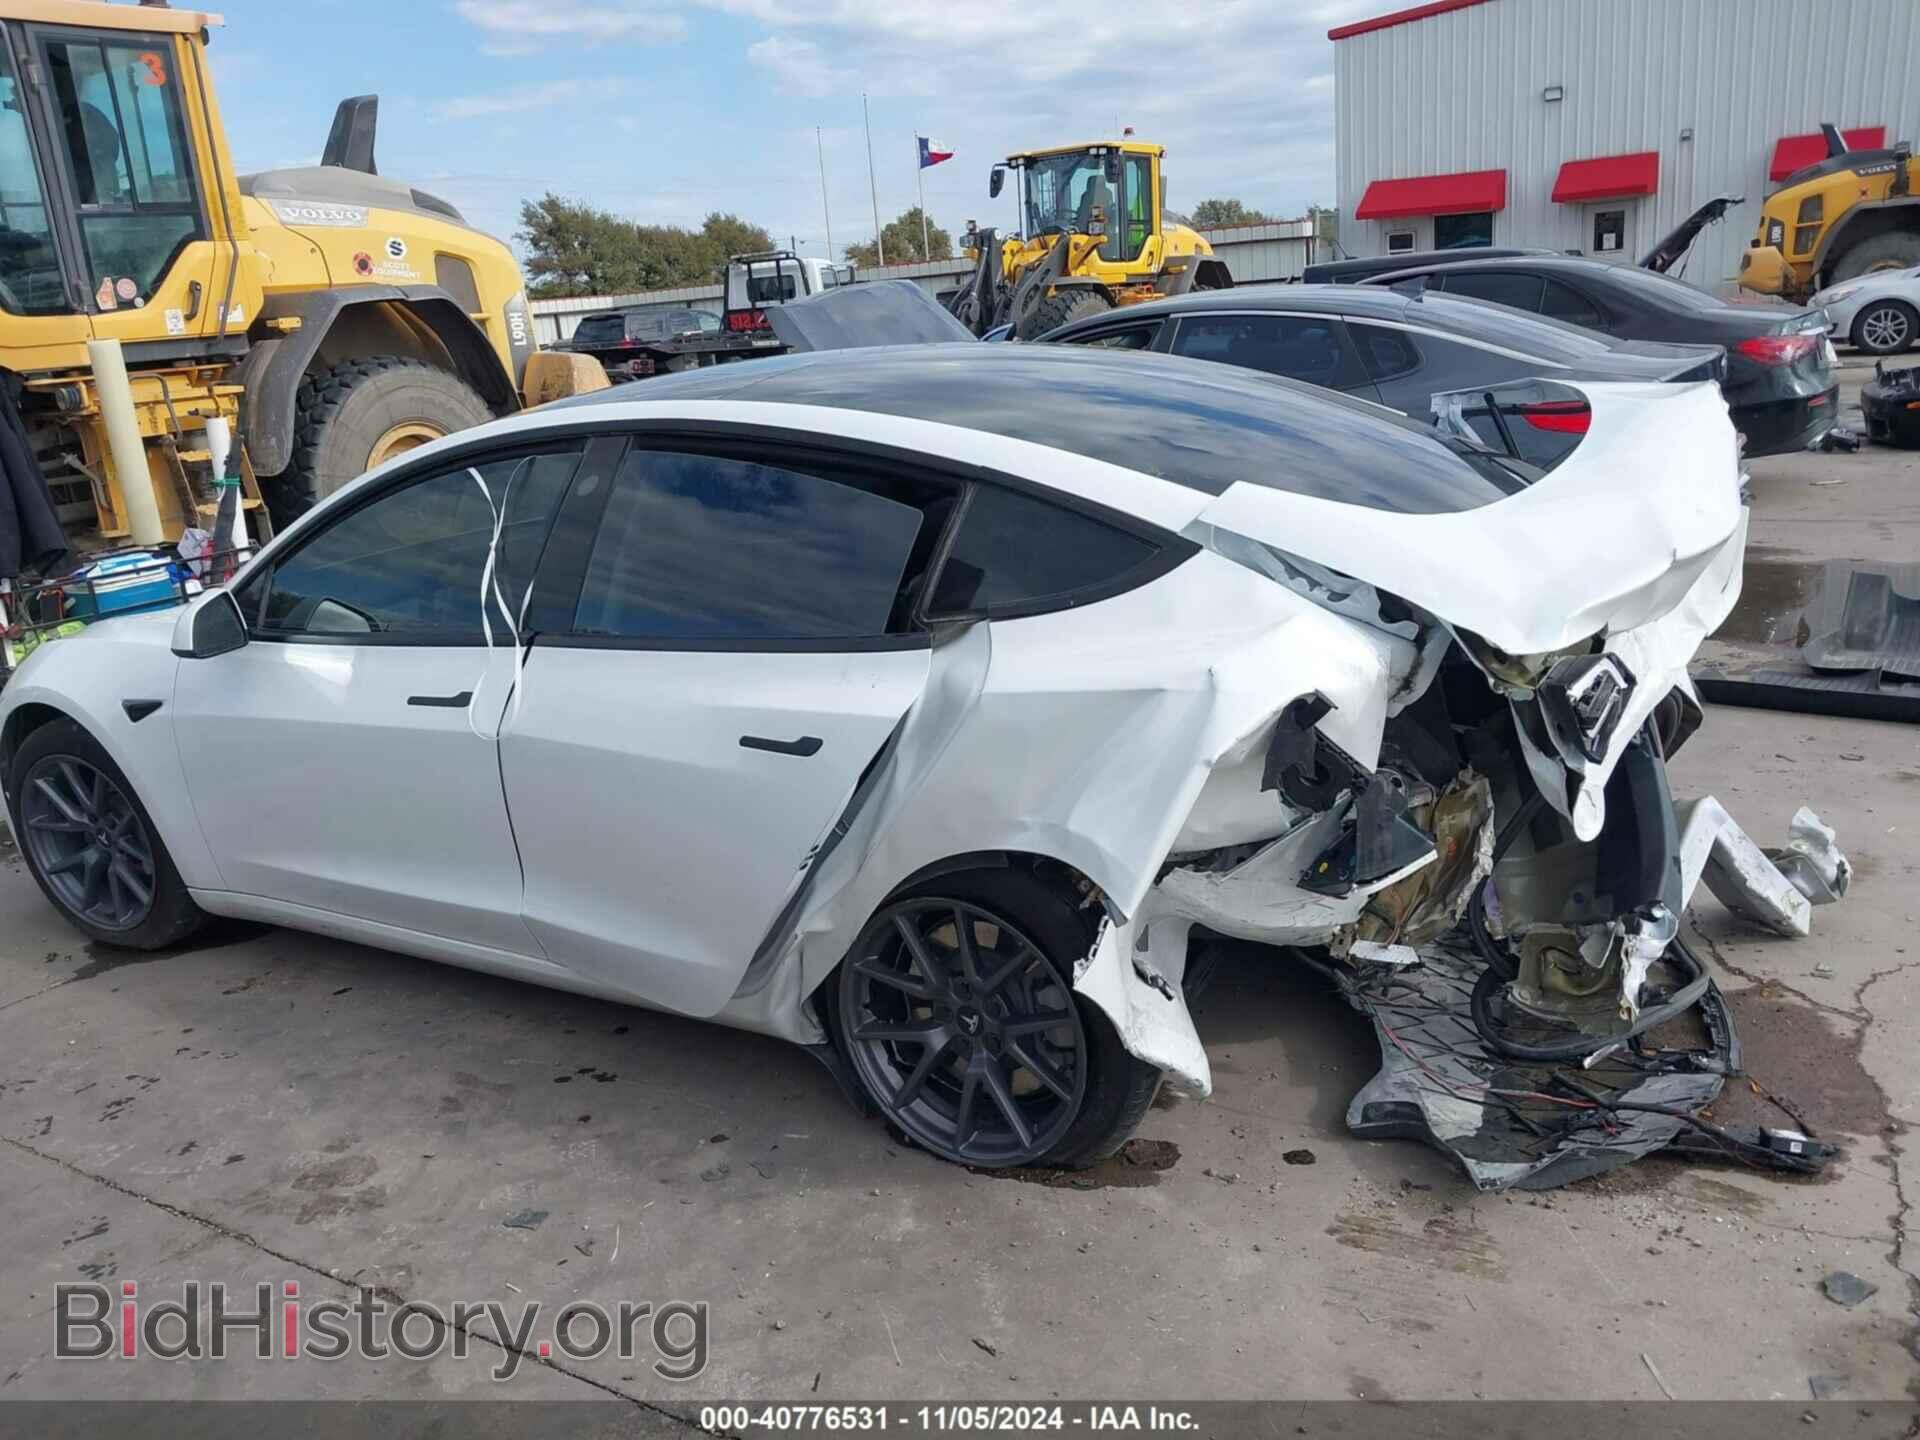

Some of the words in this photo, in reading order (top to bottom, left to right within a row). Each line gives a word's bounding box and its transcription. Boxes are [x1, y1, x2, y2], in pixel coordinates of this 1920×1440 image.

[139, 52, 167, 87] 3
[1858, 164, 1897, 175] VOLV
[284, 207, 361, 221] VOLVO
[509, 312, 527, 346] L90H
